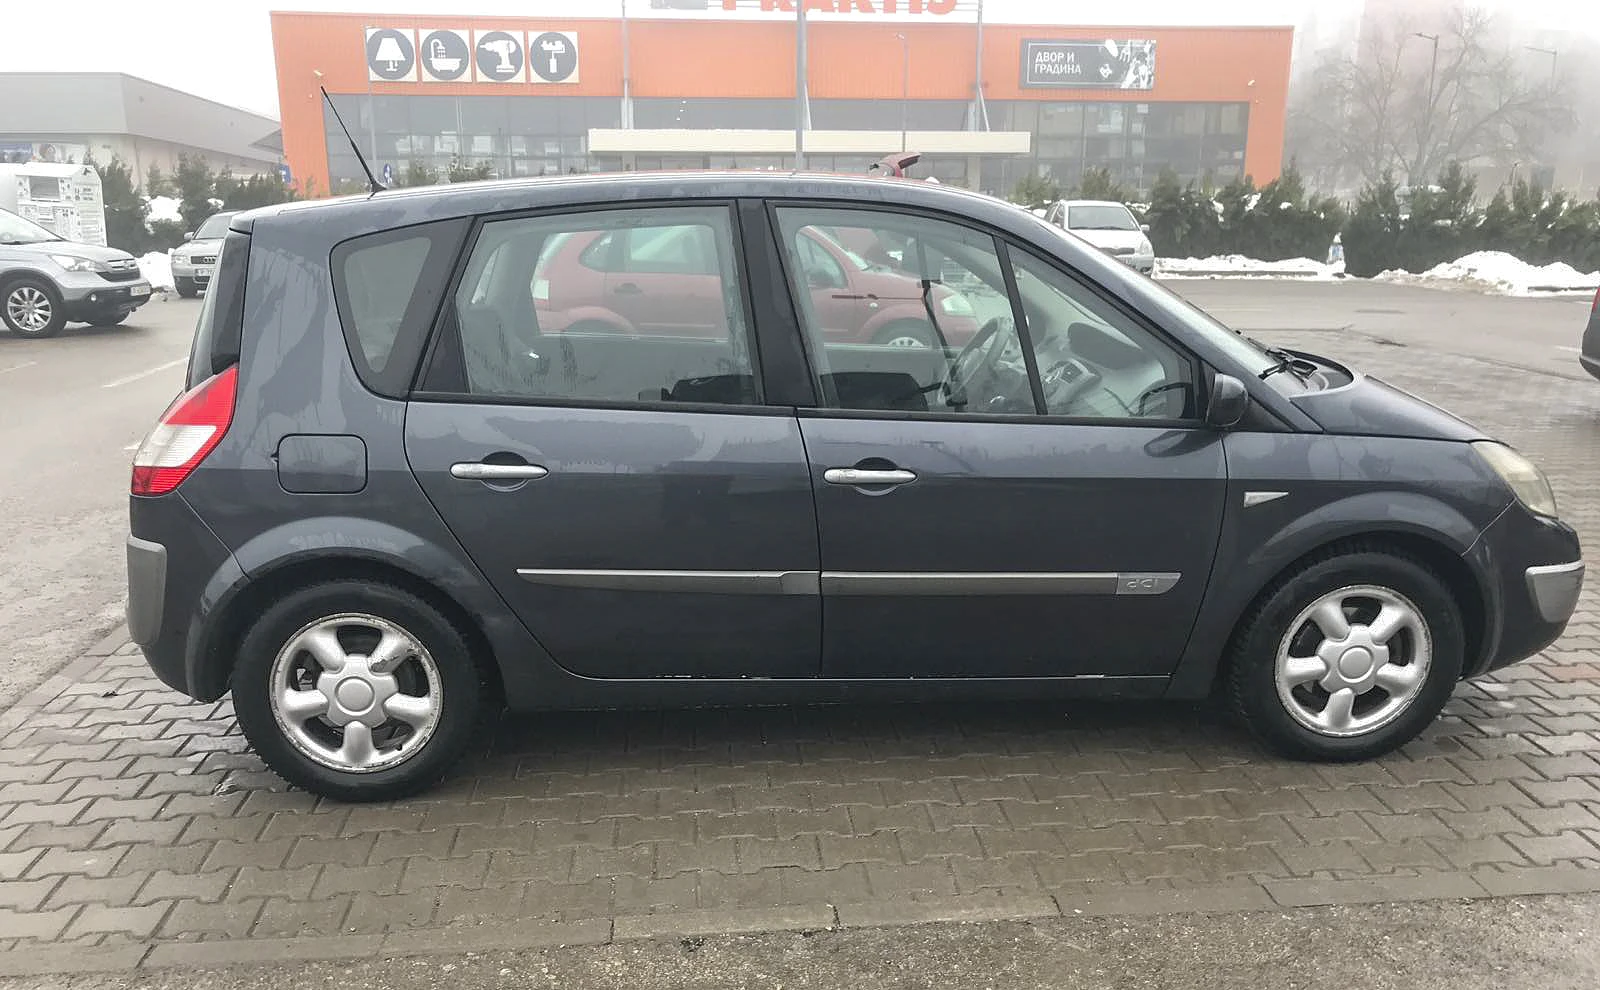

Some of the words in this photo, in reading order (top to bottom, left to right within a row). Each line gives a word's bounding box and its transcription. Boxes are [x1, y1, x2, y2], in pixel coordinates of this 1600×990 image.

[1035, 51, 1063, 64] ДВОР
[1066, 52, 1075, 63] И
[1034, 63, 1081, 75] ГРАДИНА
